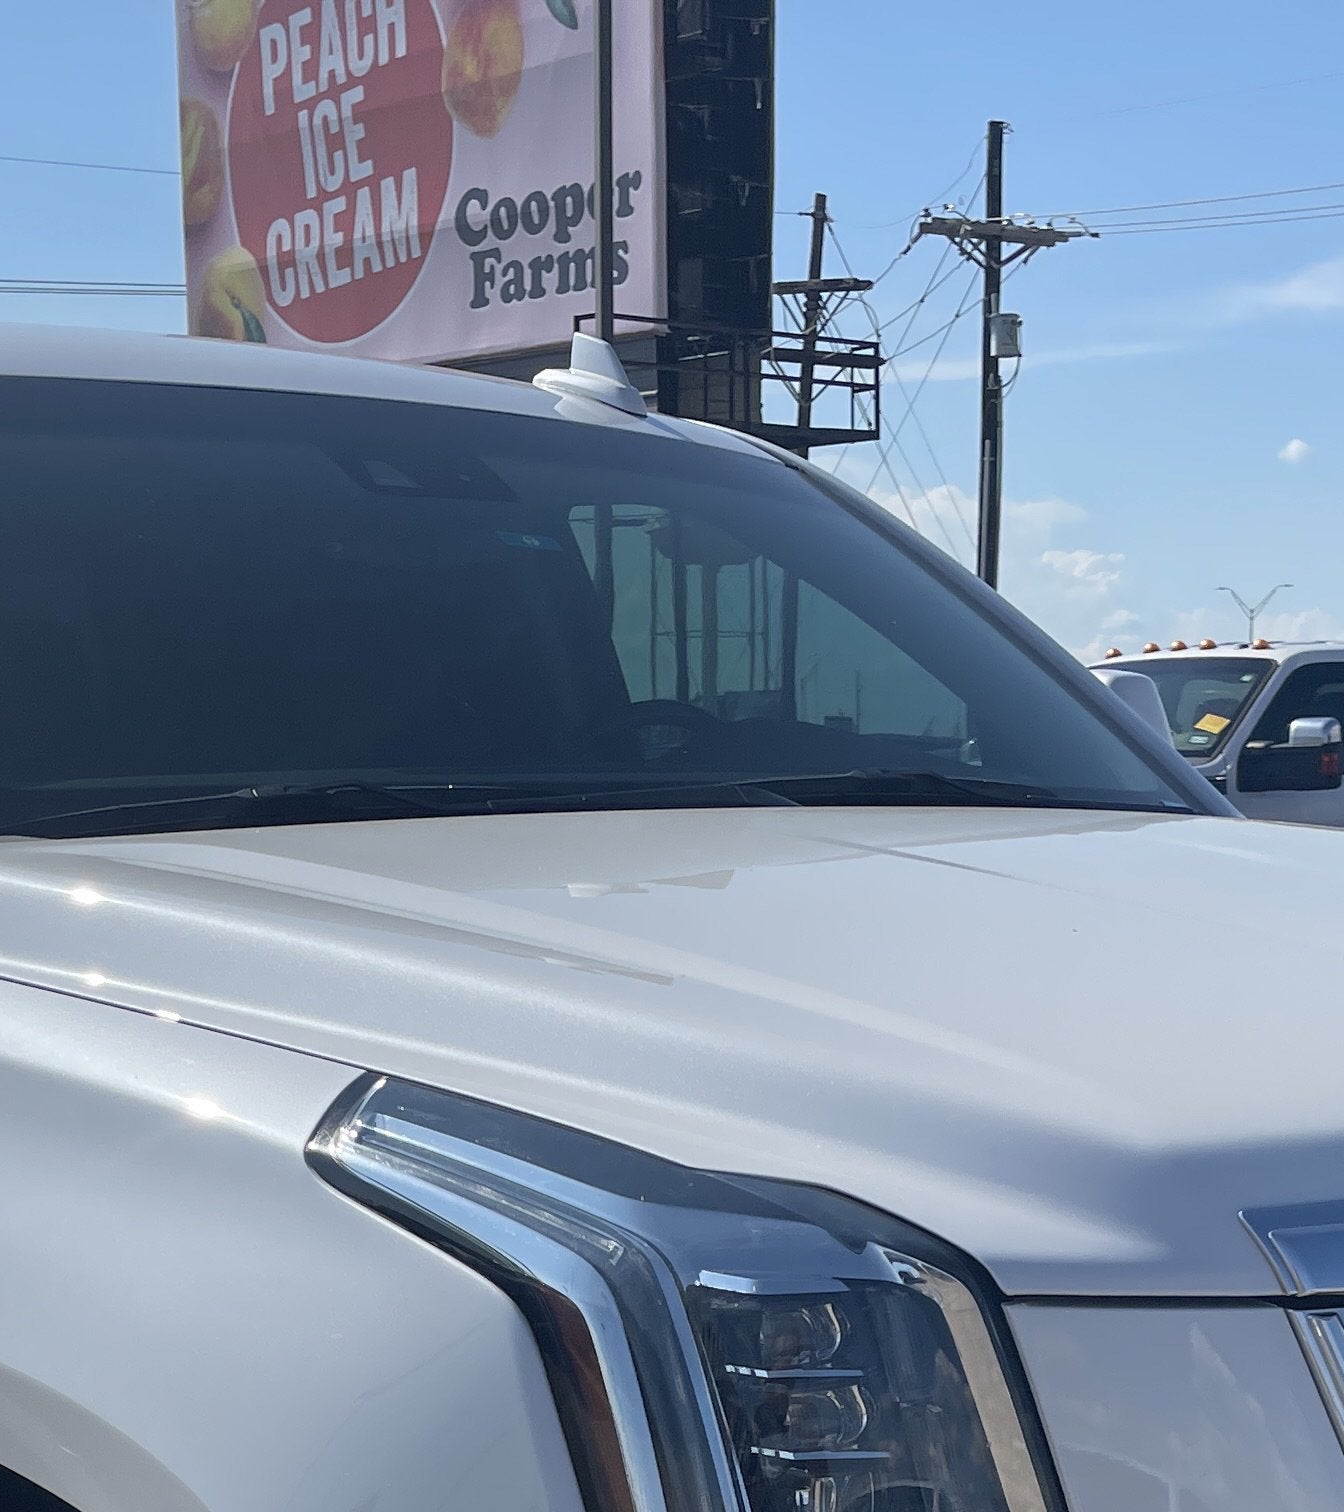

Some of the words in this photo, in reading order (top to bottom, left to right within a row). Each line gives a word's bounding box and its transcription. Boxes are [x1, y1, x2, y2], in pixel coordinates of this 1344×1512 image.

[259, 0, 406, 116] PEACH
[297, 85, 374, 199] ICE
[266, 167, 421, 307] CREAM
